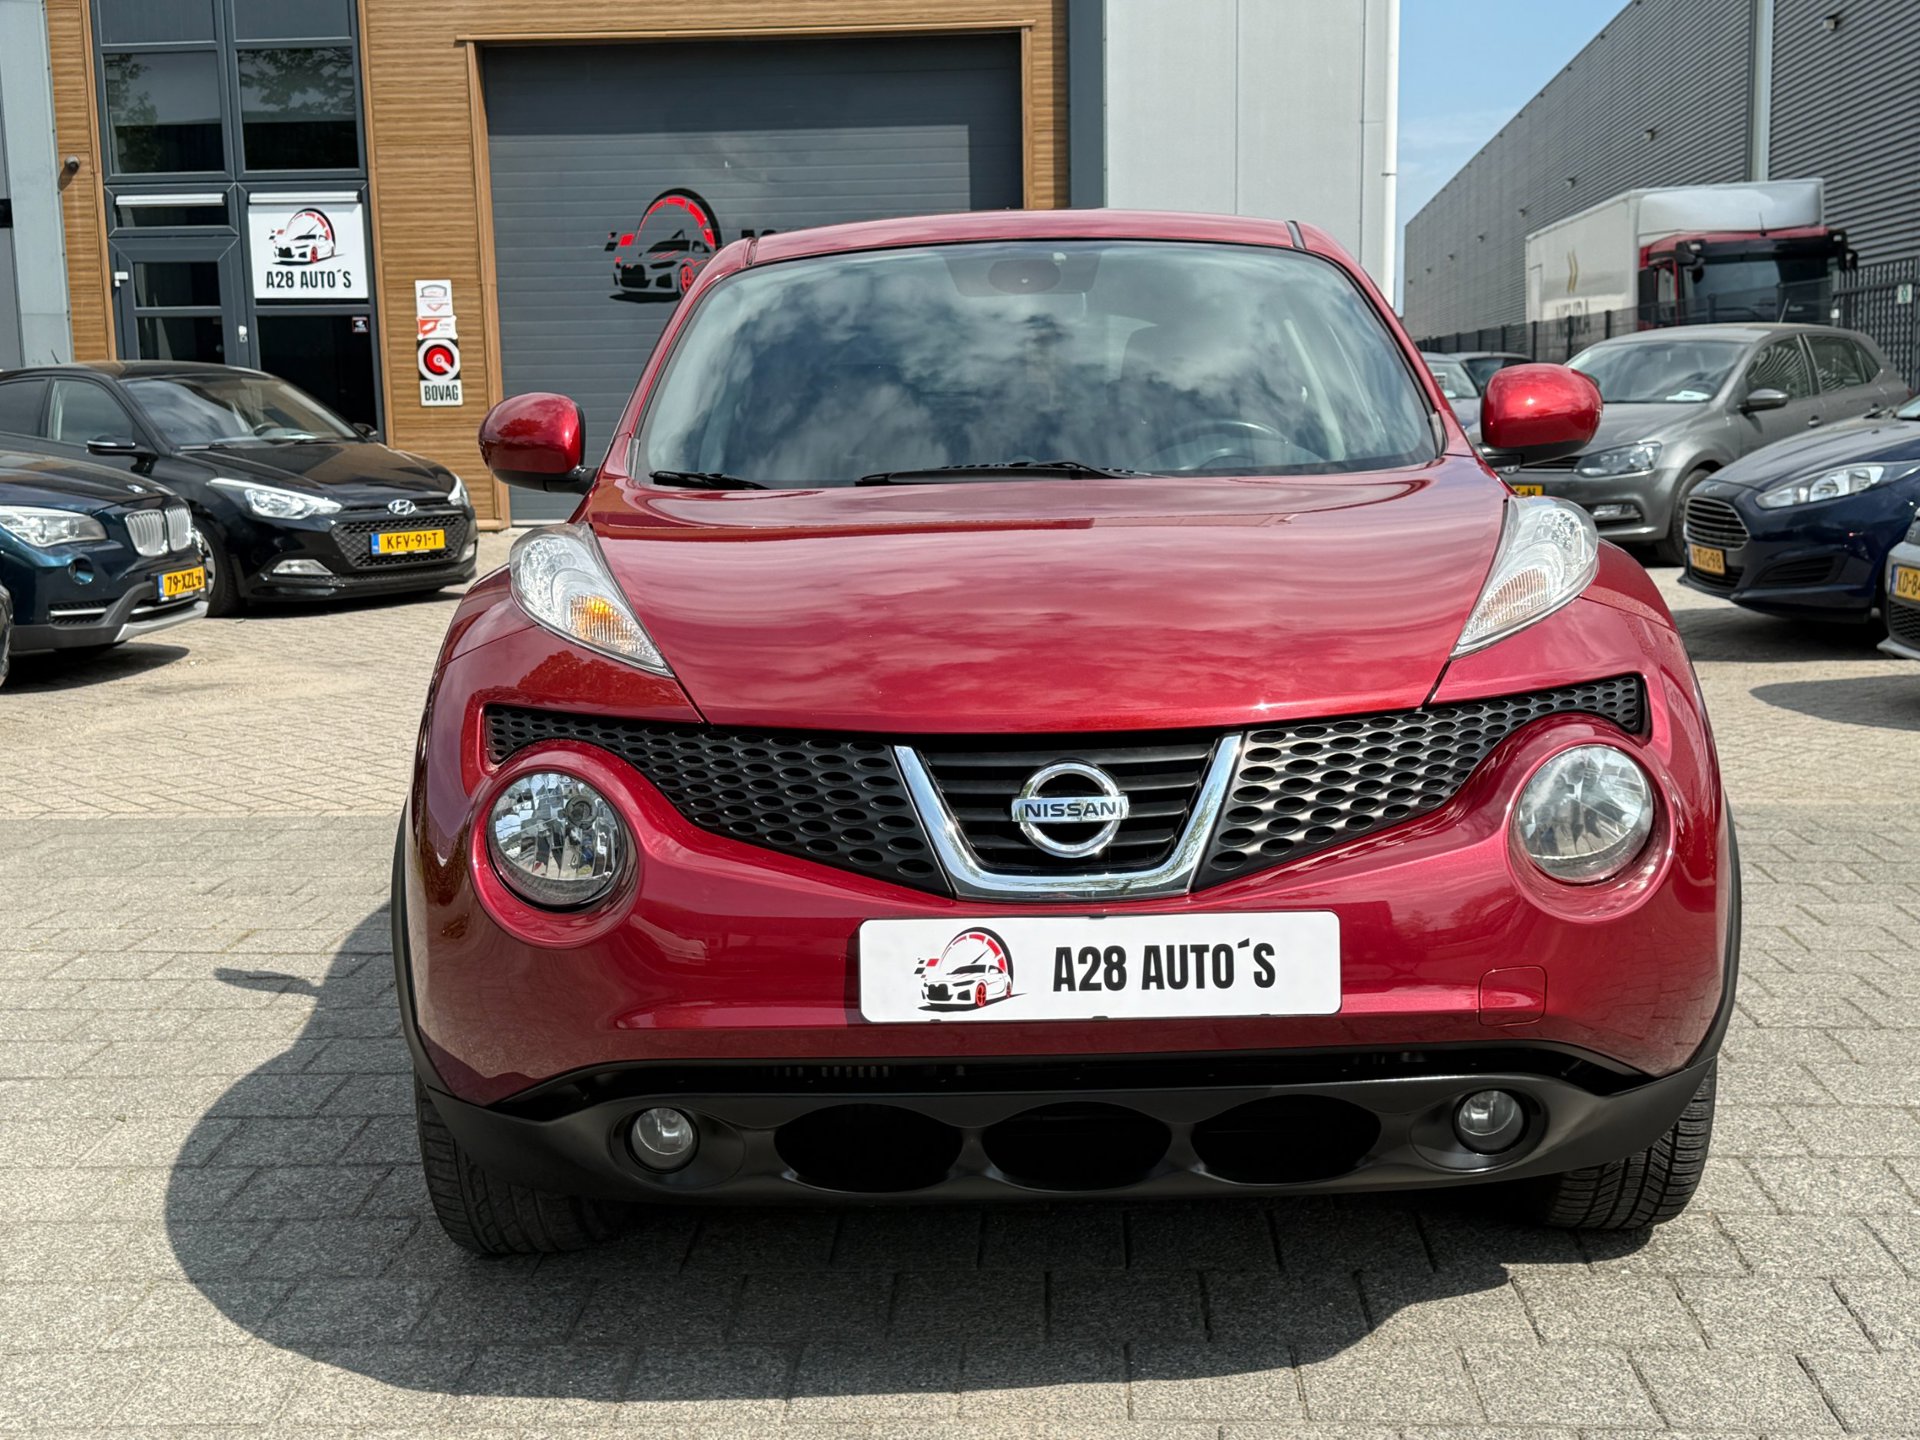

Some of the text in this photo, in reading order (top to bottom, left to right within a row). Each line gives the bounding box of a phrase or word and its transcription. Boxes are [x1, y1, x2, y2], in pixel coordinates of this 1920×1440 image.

[266, 271, 295, 289] A28
[424, 384, 459, 401] BOVAG
[386, 532, 438, 549] KFV-91-T
[1897, 571, 1920, 596] KD-8
[1024, 801, 1117, 818] NISSAN
[1052, 944, 1128, 992] A28
